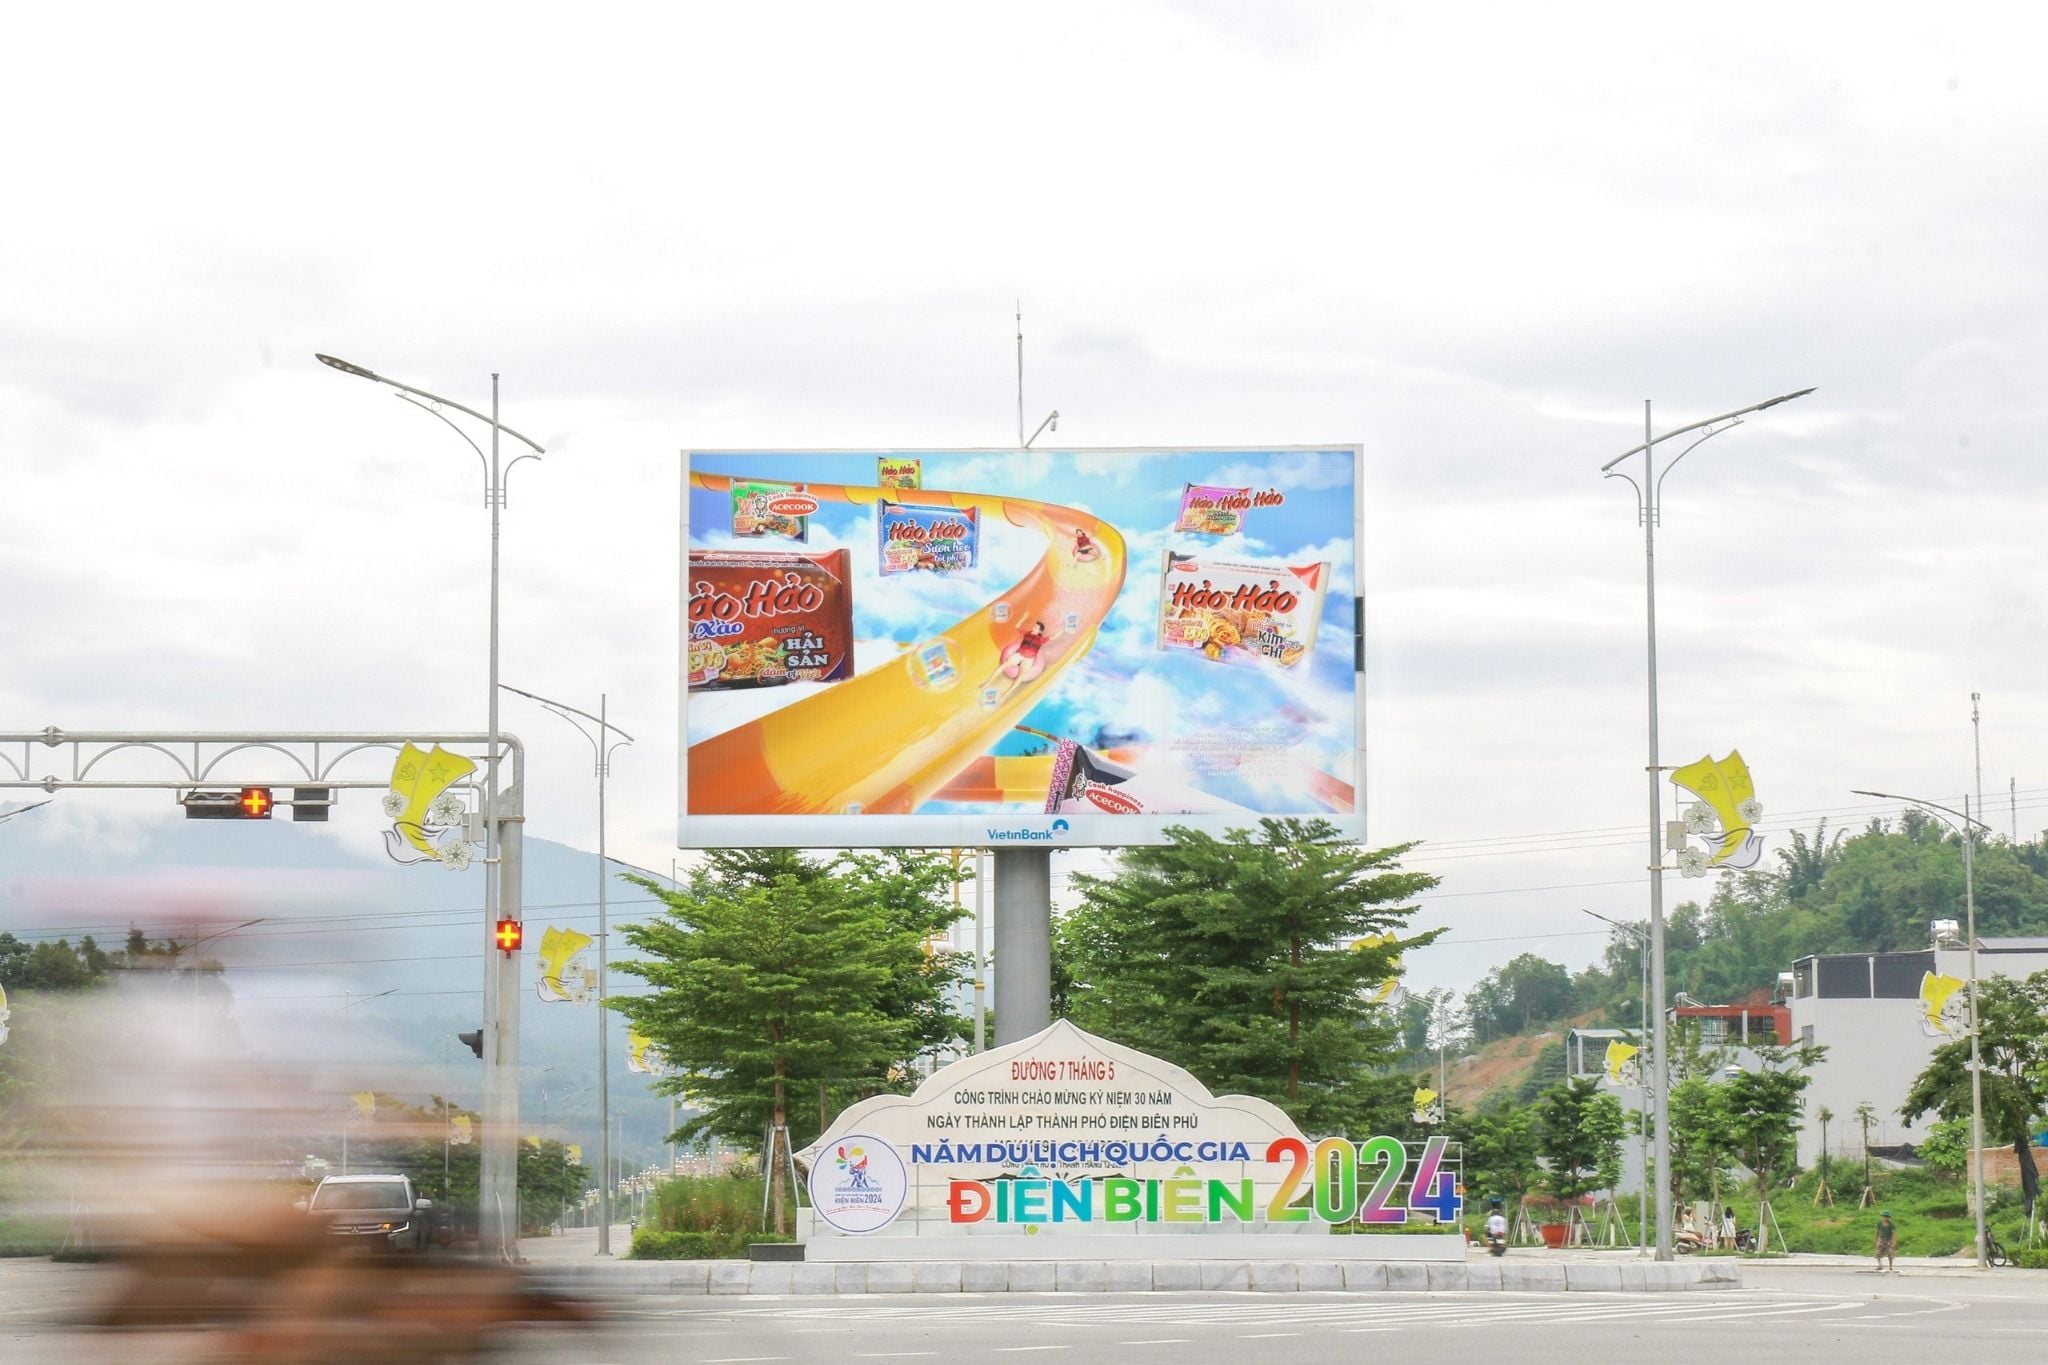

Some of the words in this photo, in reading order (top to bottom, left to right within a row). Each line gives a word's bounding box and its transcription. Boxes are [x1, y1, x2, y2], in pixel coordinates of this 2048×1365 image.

[1221, 492, 1251, 511] Hảo
[1253, 488, 1284, 507] Hảo
[889, 519, 926, 540] Hảo
[928, 517, 967, 539] Hảo
[689, 582, 741, 621] ảo
[744, 573, 824, 617] Hảo
[1172, 580, 1228, 611] Hảo
[1230, 580, 1299, 614] Hảo
[786, 632, 824, 650] HẢI
[787, 650, 829, 667] SẢN
[987, 829, 1053, 840] VietinBank
[1011, 1057, 1056, 1080] ĐƯỜNG
[1059, 1061, 1065, 1080] 7
[1068, 1056, 1105, 1080] THÁNG
[1108, 1061, 1115, 1080] 5
[954, 1089, 985, 1104] CÔNG
[988, 1089, 1019, 1104] TRÌNH
[1022, 1089, 1052, 1104] CHÀO
[1055, 1089, 1087, 1105] MỪNG
[1089, 1089, 1103, 1104] KỶ
[1107, 1090, 1131, 1108] NIỆM
[1134, 1092, 1146, 1105] 30
[1149, 1089, 1172, 1105] NĂM
[927, 1112, 961, 1128] NGÀY
[964, 1112, 1006, 1128] THÀNH
[1009, 1113, 1033, 1131] LẬP
[1036, 1112, 1078, 1128] THÀNH
[1081, 1112, 1107, 1128] PHỐ
[1110, 1113, 1138, 1132] ĐIỆN
[1142, 1113, 1170, 1128] BIÊN
[1173, 1113, 1198, 1128] PHỦ
[911, 1138, 982, 1164] NĂM
[986, 1143, 1028, 1163] DU
[1034, 1143, 1100, 1169] LỊCH
[1105, 1133, 1193, 1166] QUỐC
[1197, 1141, 1251, 1162] GIA
[946, 1165, 1093, 1235] ĐIỆN
[1104, 1165, 1255, 1223] BIÊN
[1265, 1136, 1464, 1224] 2024
[865, 1193, 882, 1204] 2024
